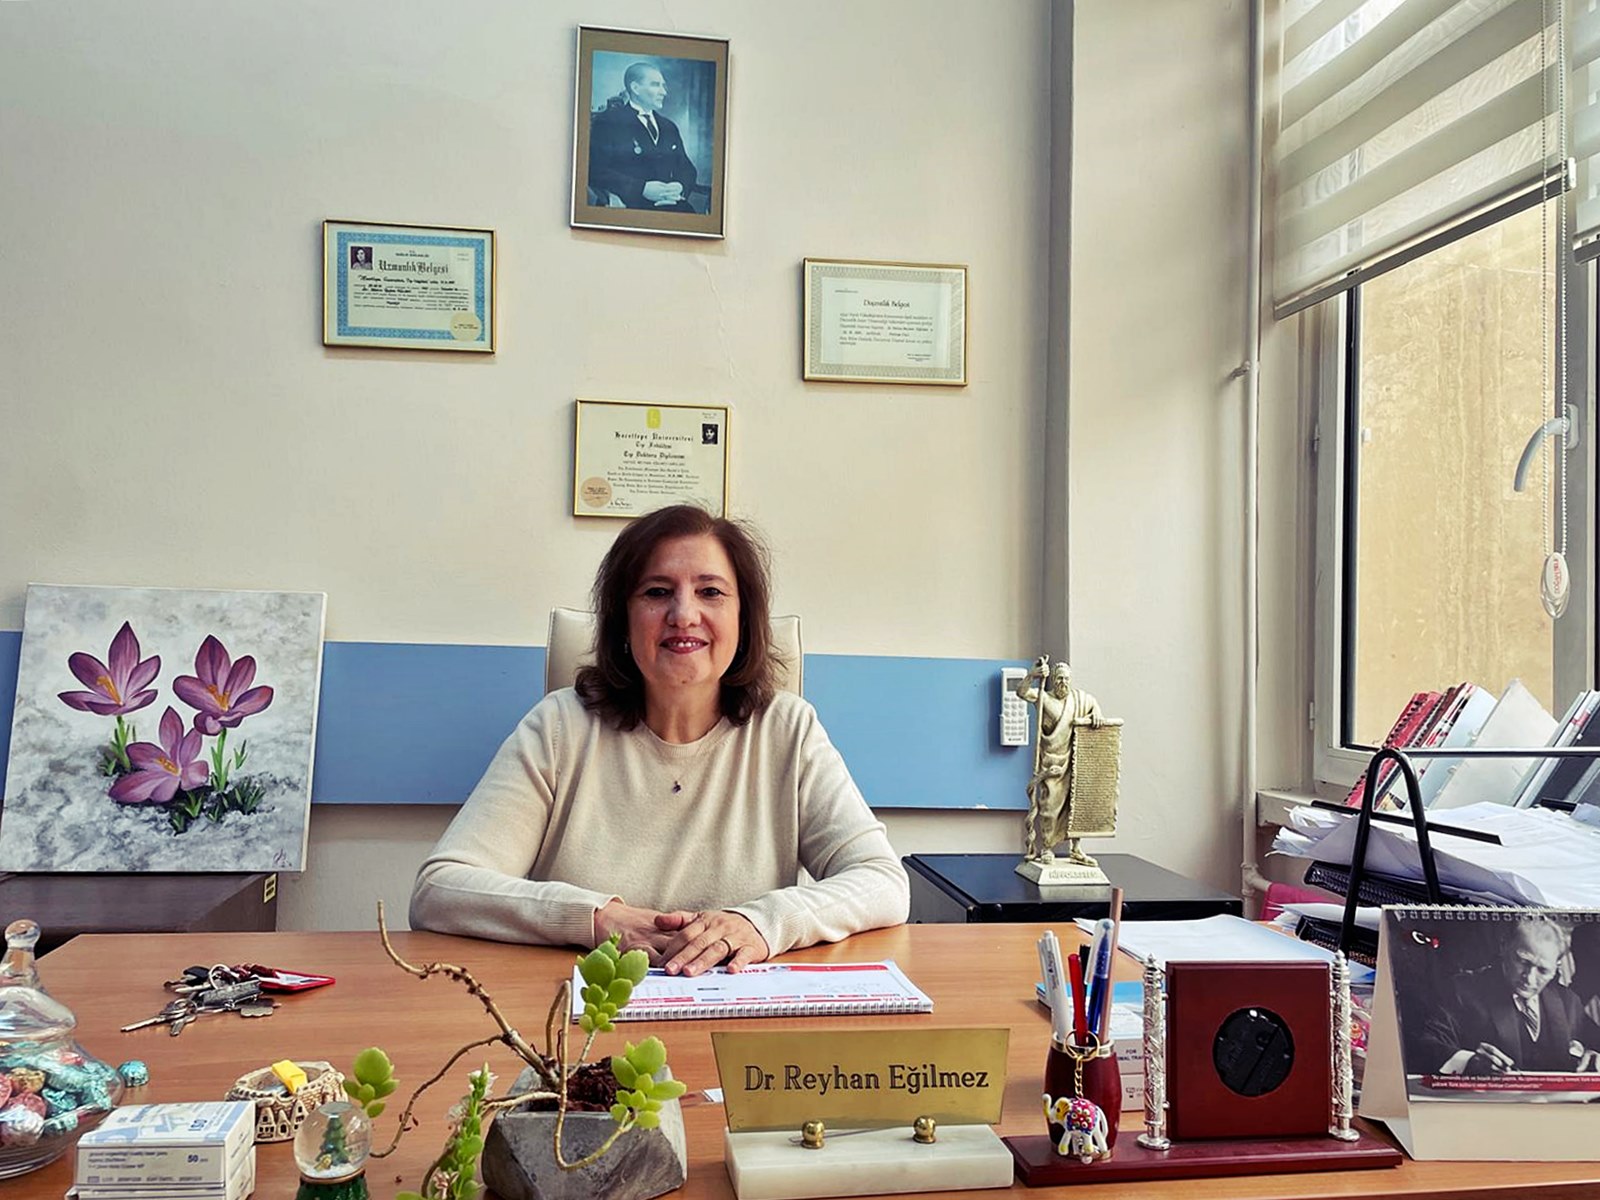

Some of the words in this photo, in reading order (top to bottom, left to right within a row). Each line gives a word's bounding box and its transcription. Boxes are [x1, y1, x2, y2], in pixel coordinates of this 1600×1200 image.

[784, 1065, 880, 1096] Reyhan
[889, 1064, 989, 1095] Eğilmez
[187, 1154, 199, 1163] 50
